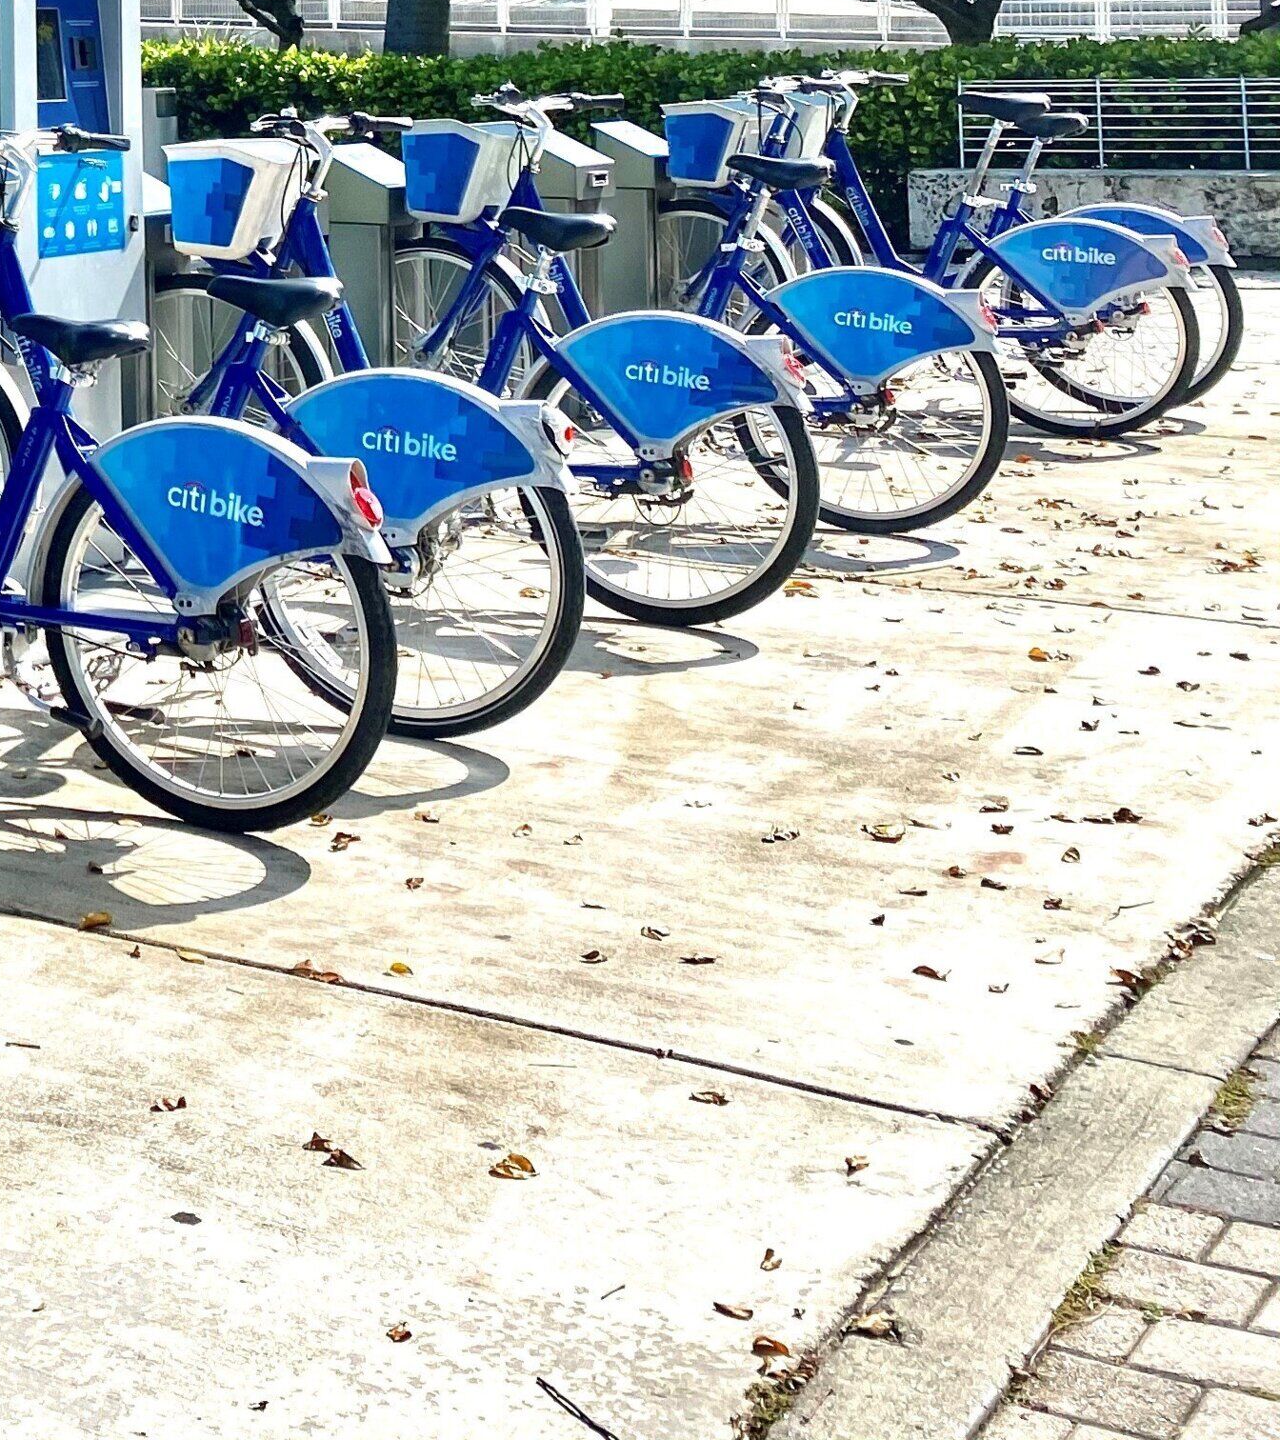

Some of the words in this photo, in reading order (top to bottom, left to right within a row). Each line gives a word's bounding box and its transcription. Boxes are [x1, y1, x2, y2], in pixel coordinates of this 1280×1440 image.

[1042, 245, 1072, 262] citi
[1074, 246, 1116, 266] bike
[834, 311, 867, 329] citi
[869, 312, 913, 335] bike
[625, 361, 659, 384] citi
[662, 364, 711, 391] bike
[362, 429, 400, 454] citi
[404, 431, 457, 462] bike
[167, 485, 206, 513] citi
[209, 488, 264, 527] bike
